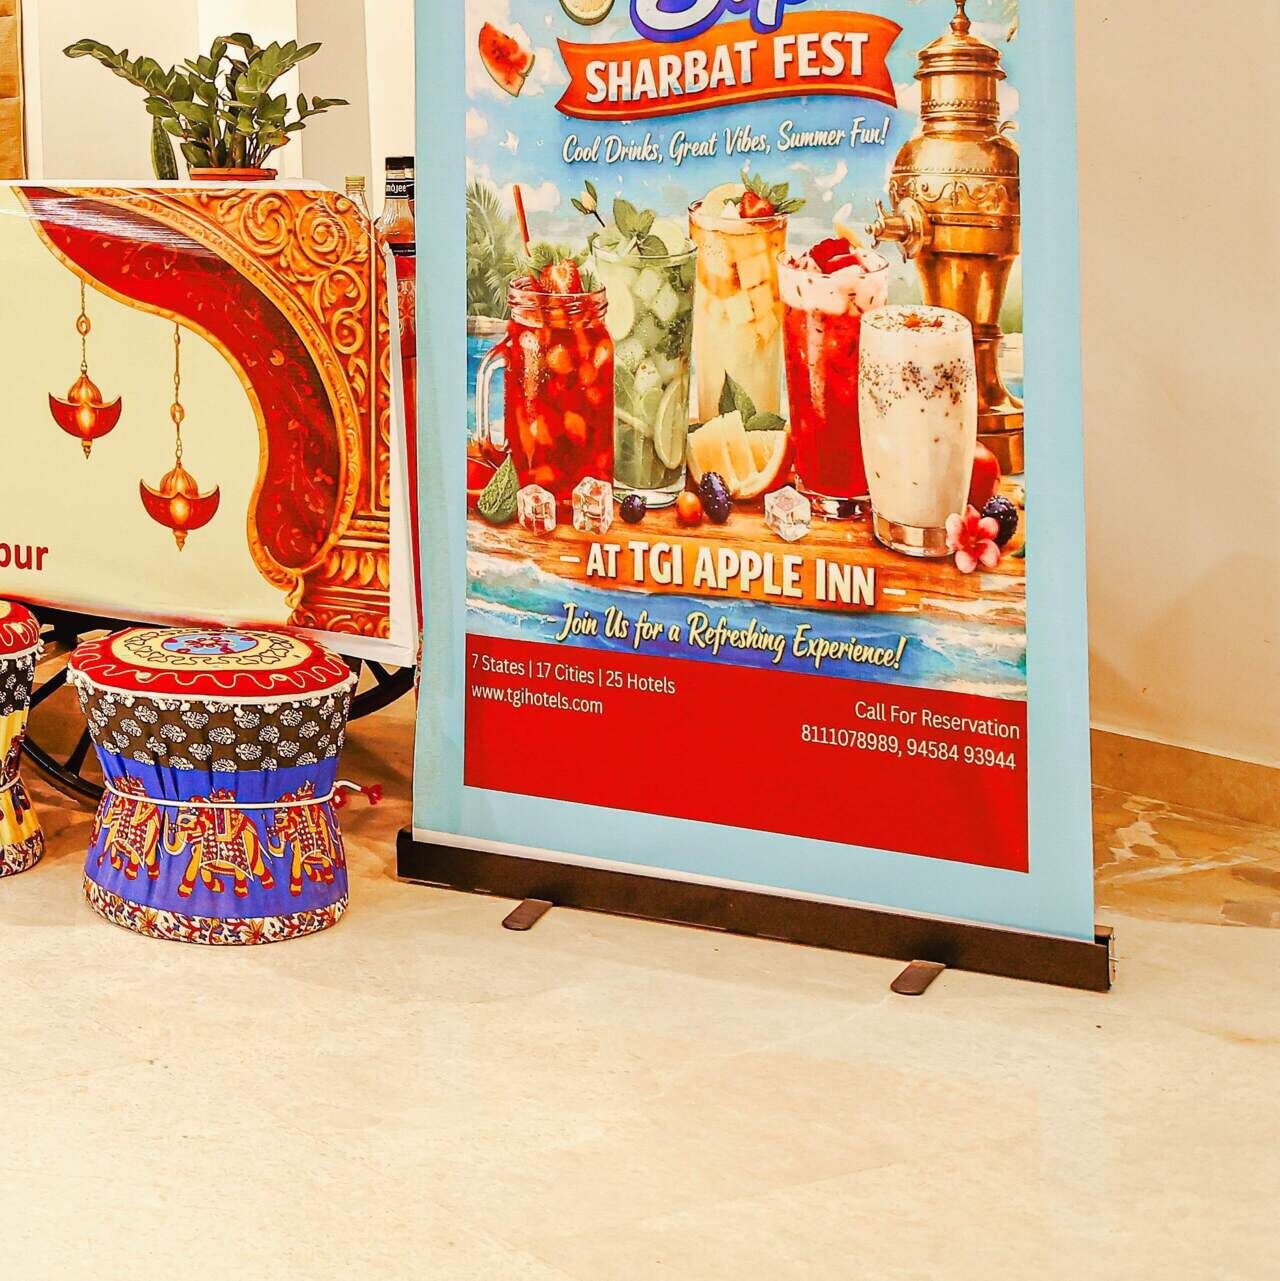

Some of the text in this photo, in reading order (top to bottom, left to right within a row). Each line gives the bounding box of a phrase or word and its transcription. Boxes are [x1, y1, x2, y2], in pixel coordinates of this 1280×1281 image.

[585, 32, 869, 104] SHARBAT FEST
[562, 117, 891, 166] Cool Drinks, Great Vibes, Summer Fun!
[586, 540, 875, 606] AT TGI APPLE INN
[555, 602, 908, 670] Join Us for a Refreshing Experience!
[471, 653, 479, 669] 7
[481, 655, 525, 676] States
[536, 662, 552, 678] 17
[554, 664, 595, 685] Cities
[606, 671, 623, 688] 25
[627, 673, 676, 695] Hotels
[471, 684, 603, 714] www.tgihotels.com
[854, 701, 1020, 740] Call For Reservation
[801, 724, 1017, 770] 8111078989, 94584 93944
